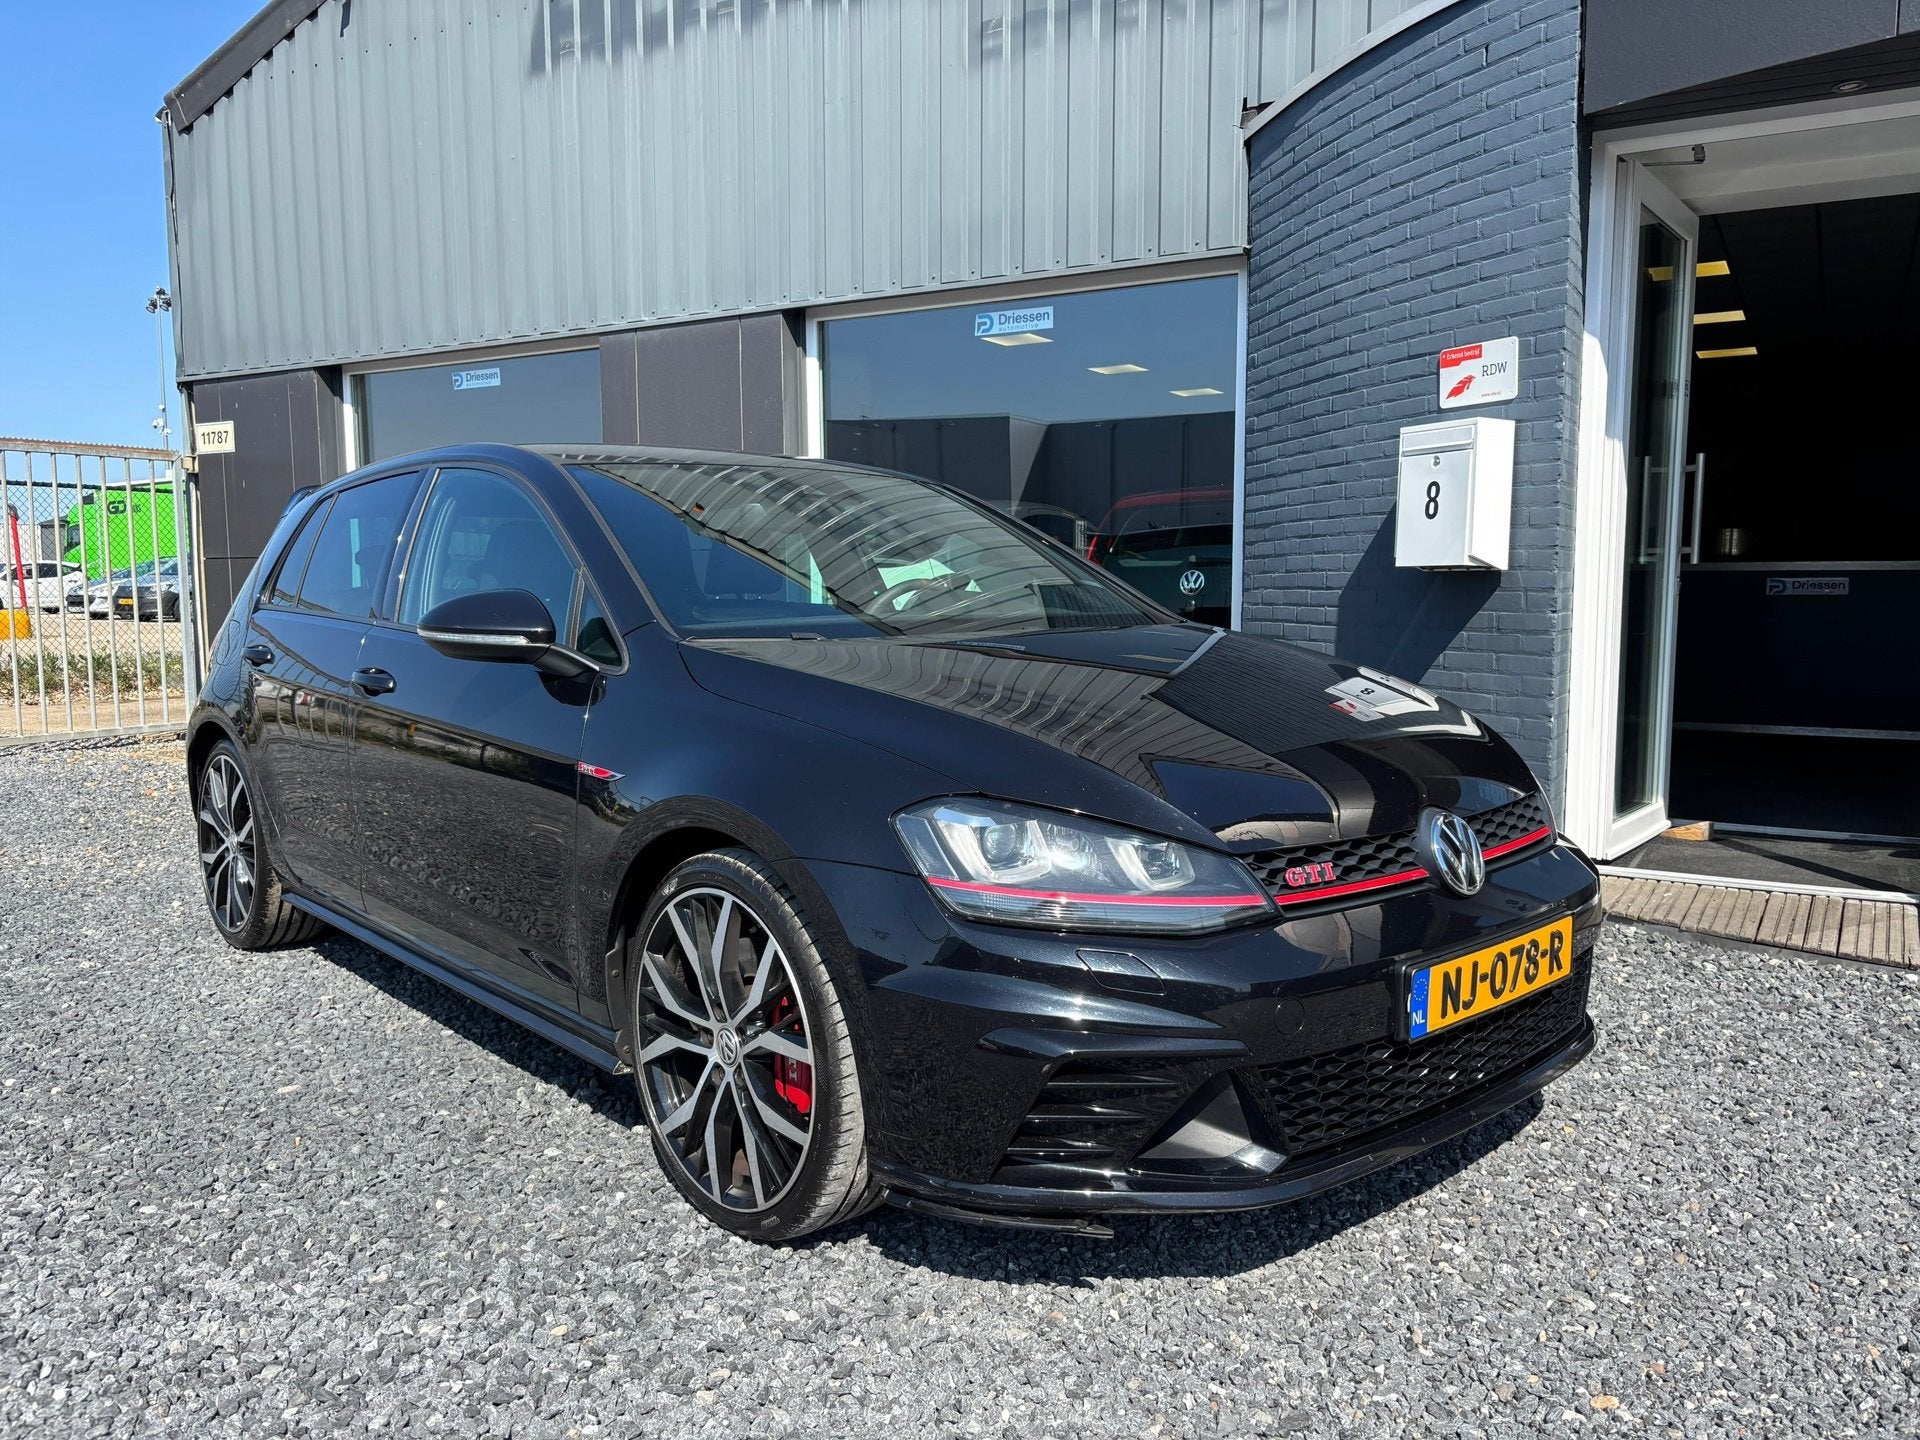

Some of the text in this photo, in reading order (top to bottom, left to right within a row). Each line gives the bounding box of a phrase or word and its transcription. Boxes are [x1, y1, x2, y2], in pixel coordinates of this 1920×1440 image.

[998, 311, 1050, 325] Driessen
[998, 323, 1039, 332] automotive
[465, 371, 499, 382] Driessen
[1481, 361, 1508, 377] RDW
[201, 430, 229, 445] 11787
[1424, 480, 1441, 520] 8
[1791, 580, 1846, 590] Driessen
[1285, 861, 1337, 887] GTI
[1440, 929, 1564, 1020] NJ-078-R
[1412, 1009, 1426, 1027] NL
